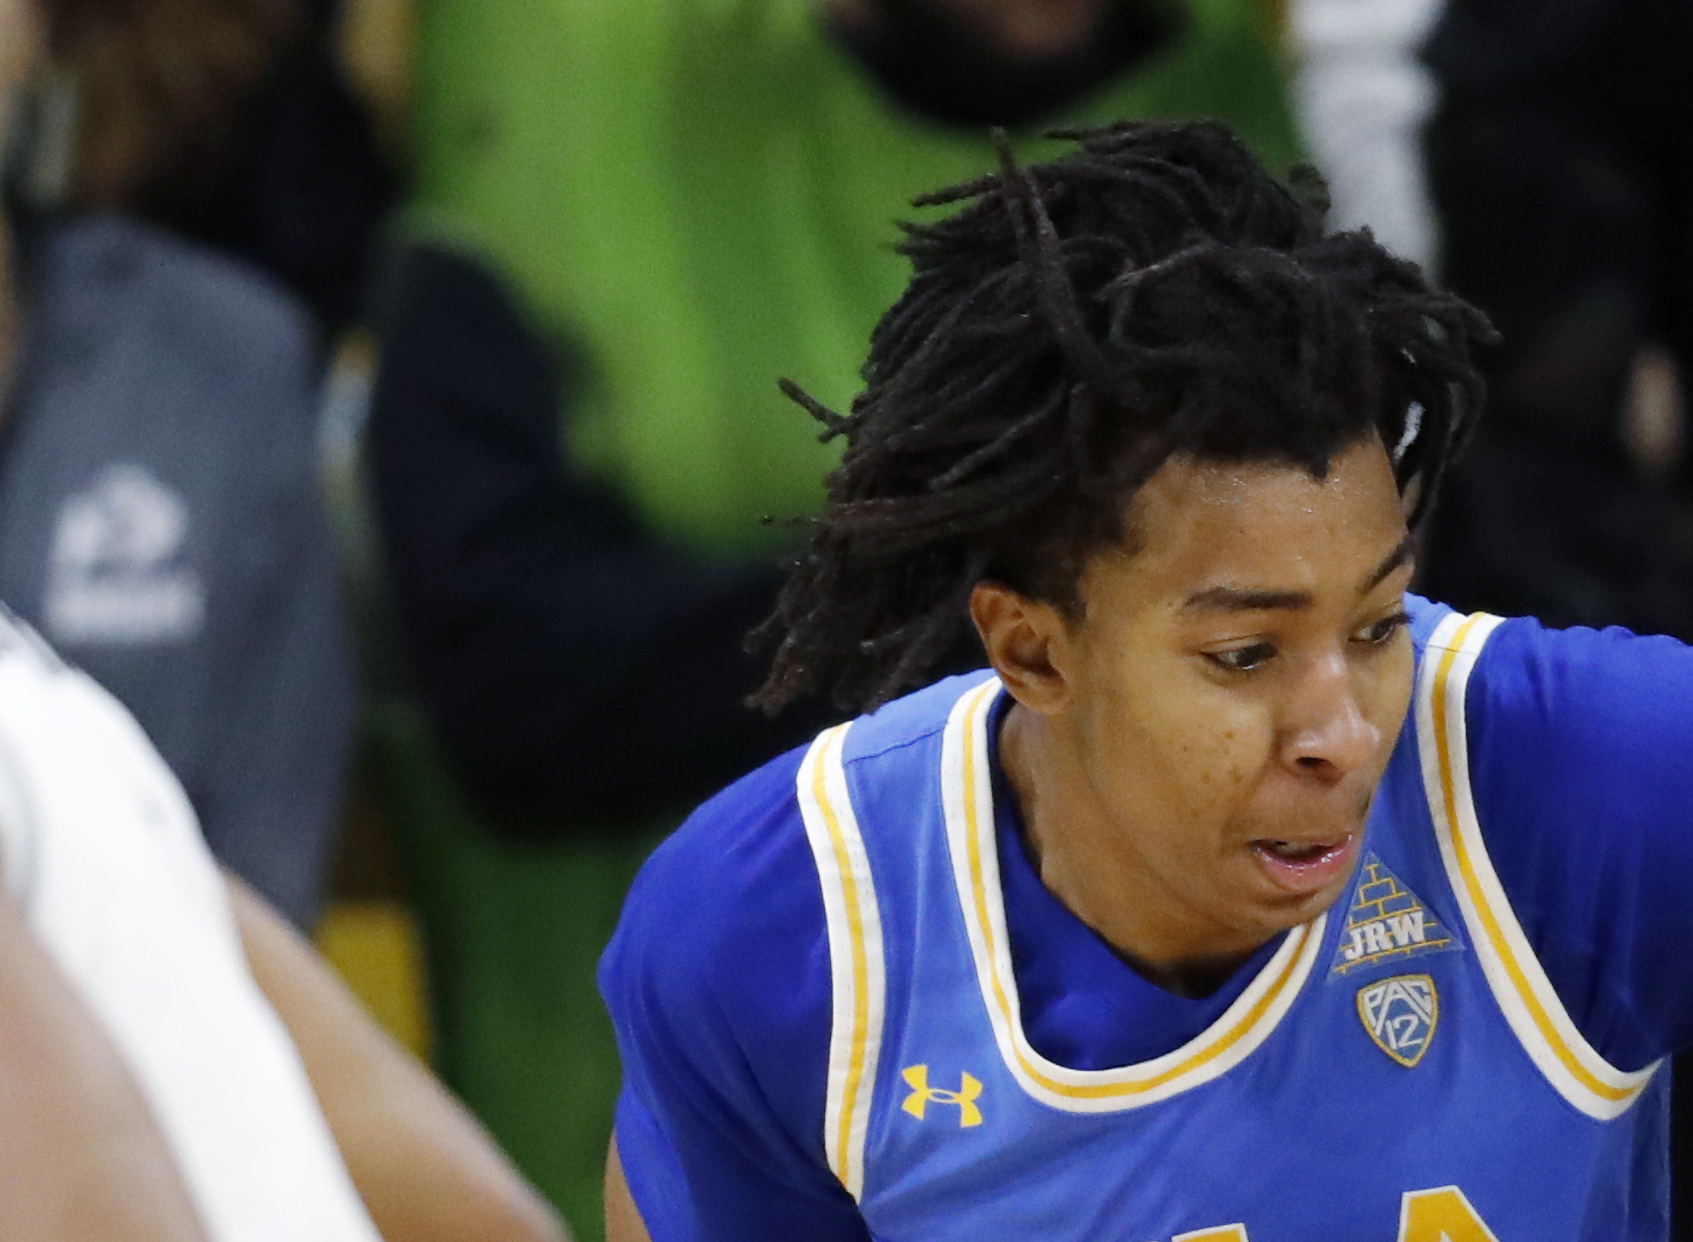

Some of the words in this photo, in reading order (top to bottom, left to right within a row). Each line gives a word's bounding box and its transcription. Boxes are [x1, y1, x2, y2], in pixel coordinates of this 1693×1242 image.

[1345, 911, 1426, 960] JRW
[1363, 980, 1432, 1036] PAC
[1384, 1014, 1424, 1050] 12
